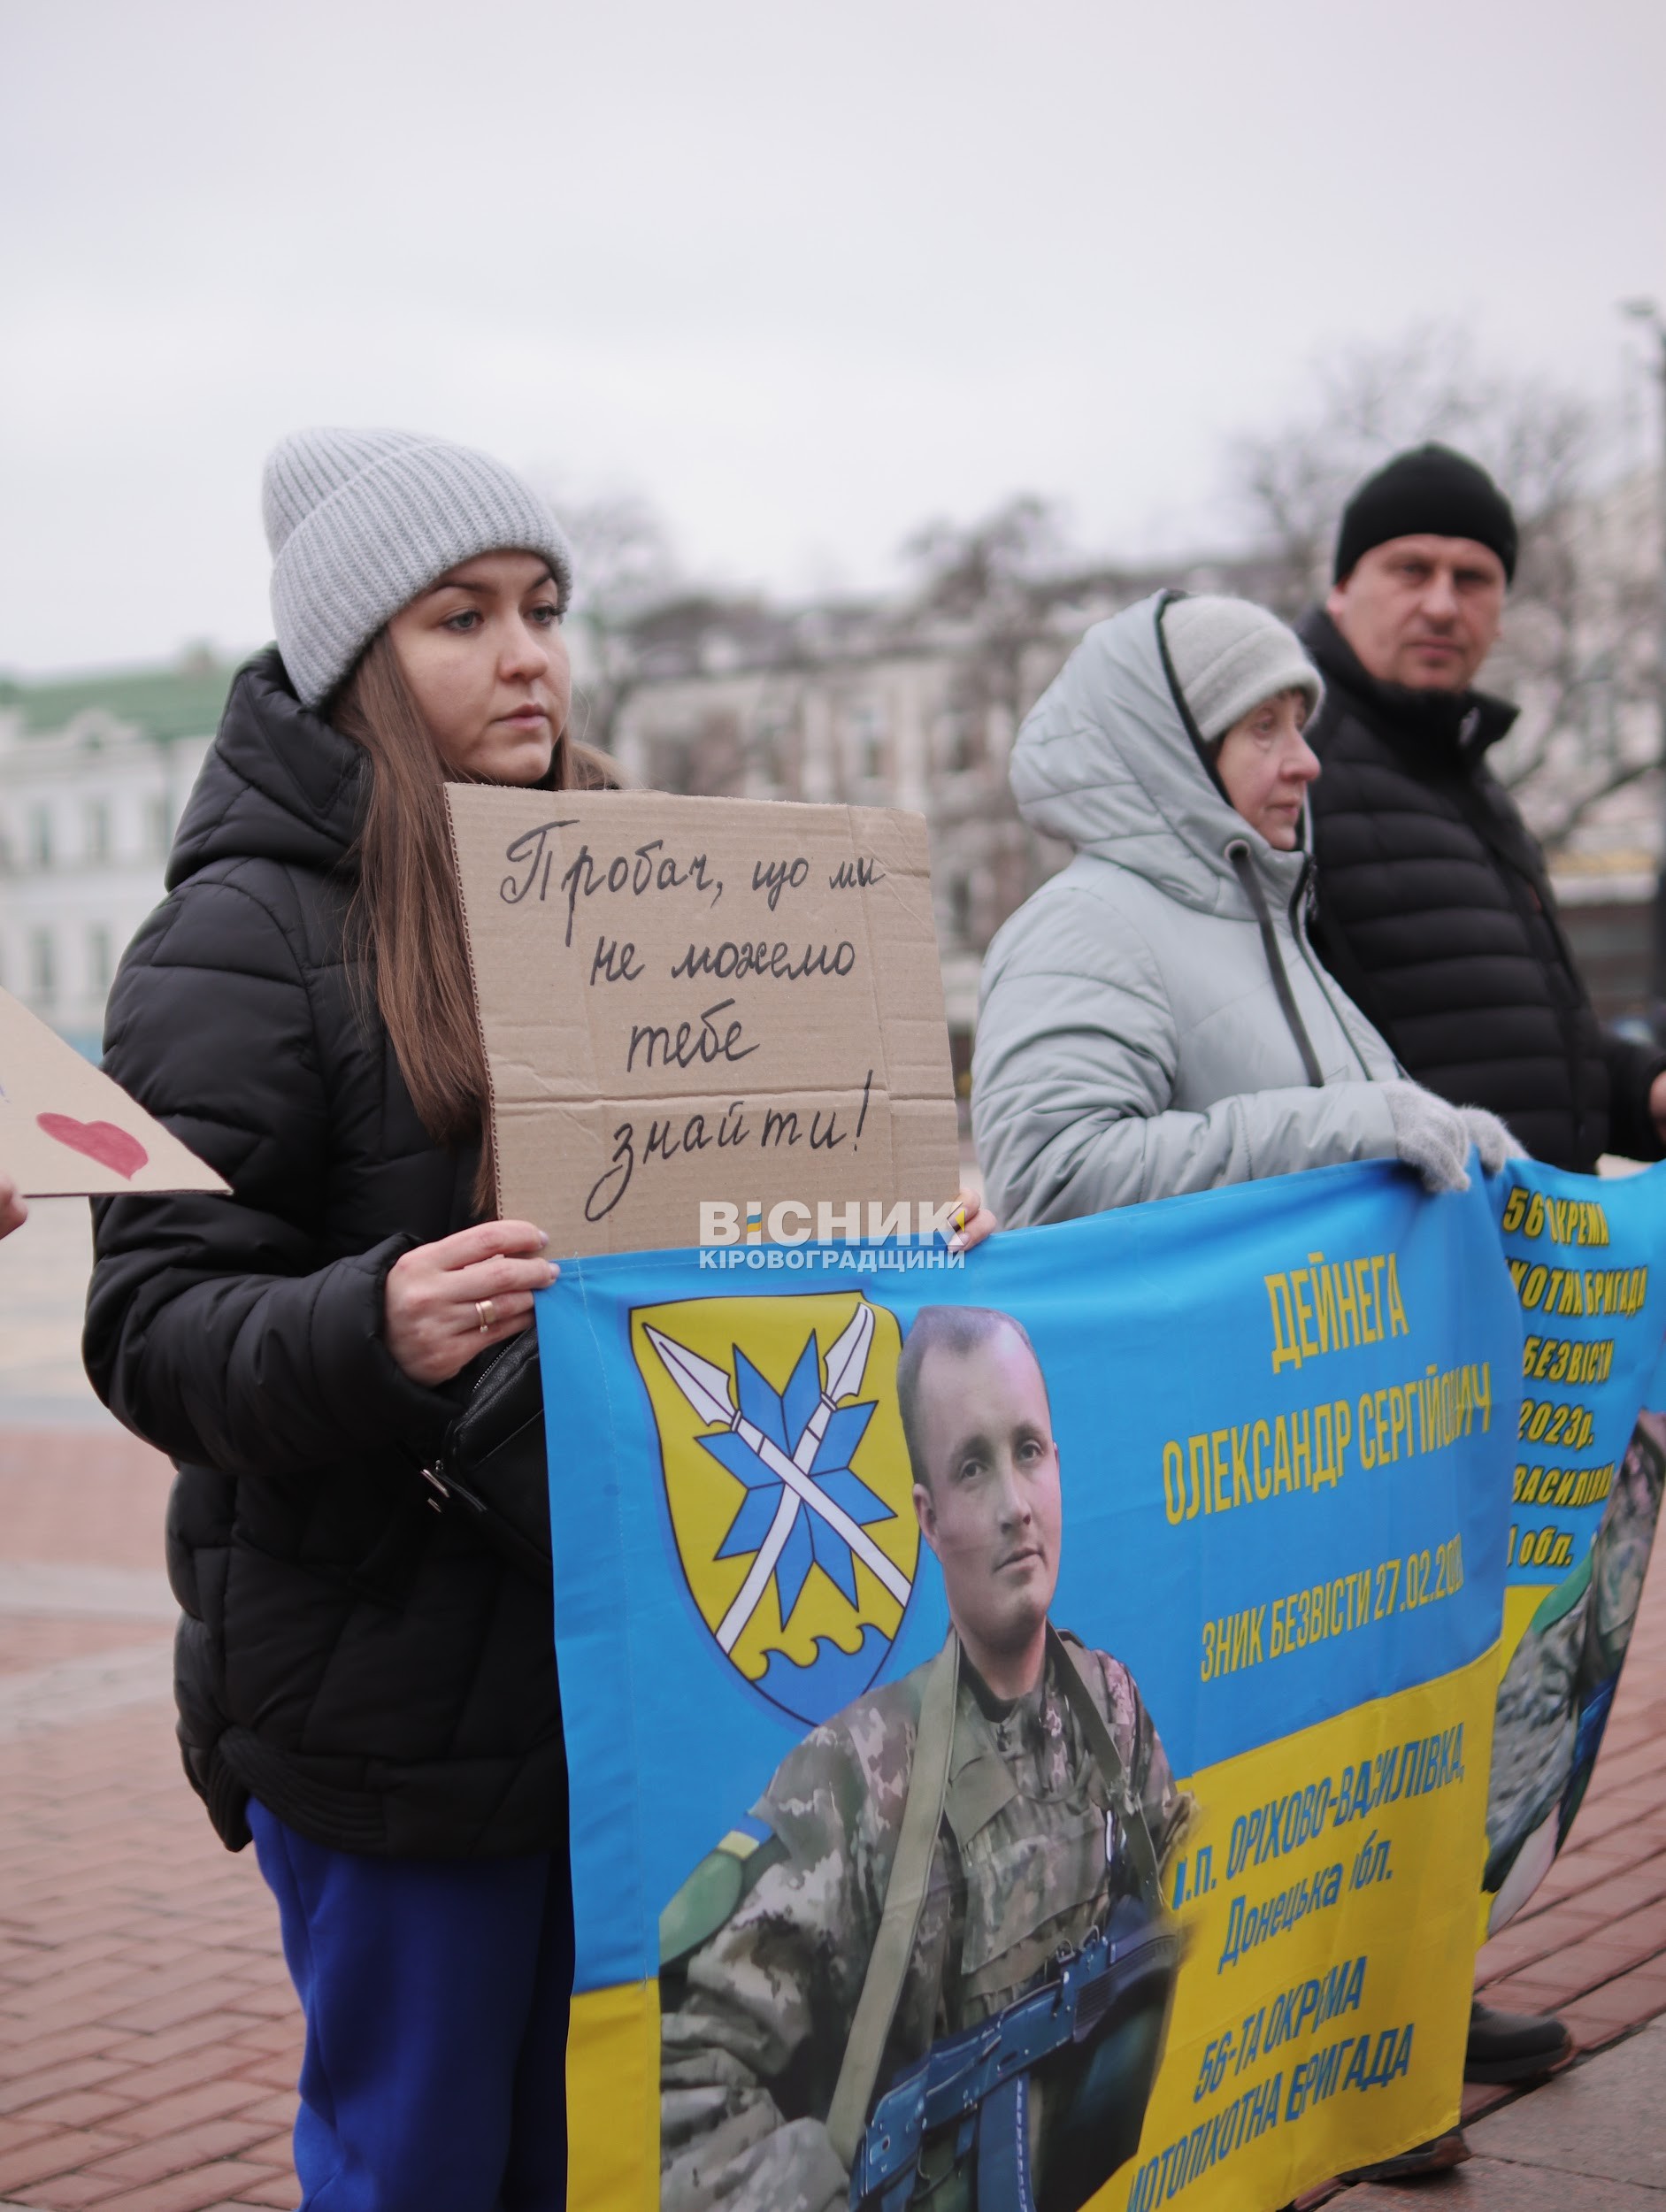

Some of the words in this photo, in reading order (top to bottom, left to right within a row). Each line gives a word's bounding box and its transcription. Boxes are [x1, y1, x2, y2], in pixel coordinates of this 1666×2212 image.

[500, 818, 725, 947] Пробач,
[751, 856, 808, 911] що
[829, 856, 886, 891] ми
[589, 934, 645, 987] не
[671, 940, 856, 980] можемо
[626, 997, 761, 1072] тебе
[584, 1069, 874, 1222] знайти!
[1502, 1185, 1546, 1239] 56
[1263, 1251, 1410, 1374] ДЕЙНЕГА
[1505, 1256, 1583, 1316] ХОТНА
[1162, 1398, 1353, 1526] ОЛЕКСАНДР
[1518, 1398, 1595, 1453] 2023р.
[1201, 1603, 1267, 1683] ЗНИК
[1269, 1568, 1372, 1660] БЕЗВІСТИ
[1374, 1531, 1464, 1621] 27.02.20
[1217, 1863, 1344, 1975] Донецька
[1194, 2006, 1266, 2103] 56-ТА
[1263, 1955, 1368, 2055] ОКРМА
[1284, 2023, 1415, 2124] БРИГАДА
